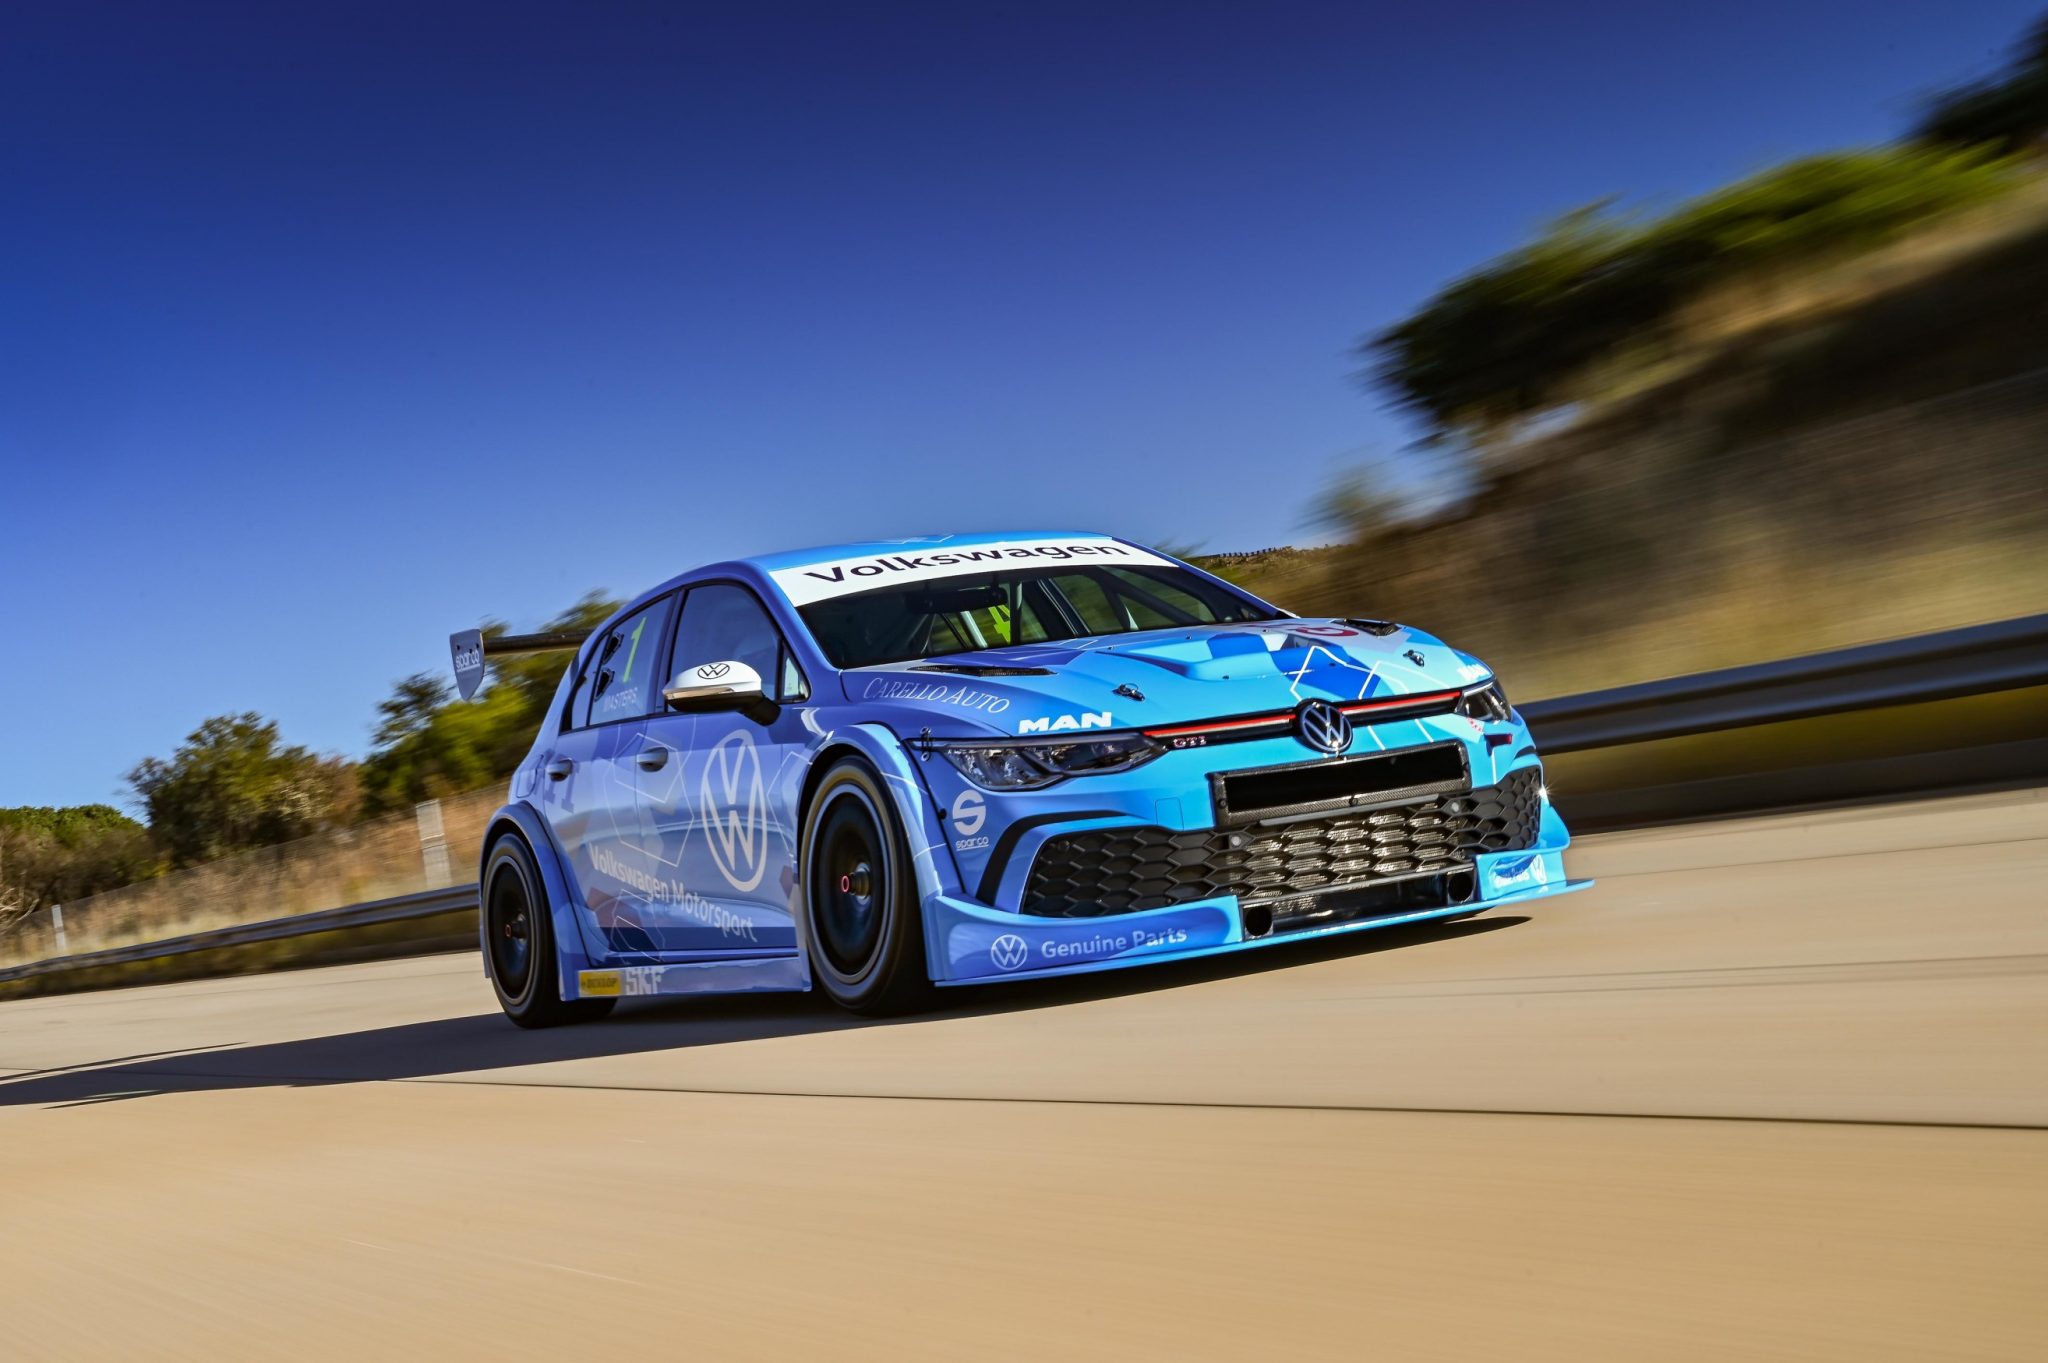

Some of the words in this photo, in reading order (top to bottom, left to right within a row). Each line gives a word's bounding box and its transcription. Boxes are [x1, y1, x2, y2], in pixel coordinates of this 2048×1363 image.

[803, 545, 1130, 583] Volkswagen
[863, 677, 948, 702] CARELLO
[943, 685, 1010, 714] AUTO
[1018, 711, 1112, 734] MAN
[1173, 736, 1207, 748] GTI
[955, 836, 989, 850] sparco
[588, 841, 670, 903] Volkswagen
[671, 878, 758, 943] Motorsport
[1041, 936, 1127, 958] Genuine
[1133, 927, 1188, 947] Parts
[625, 966, 665, 996] SKF
